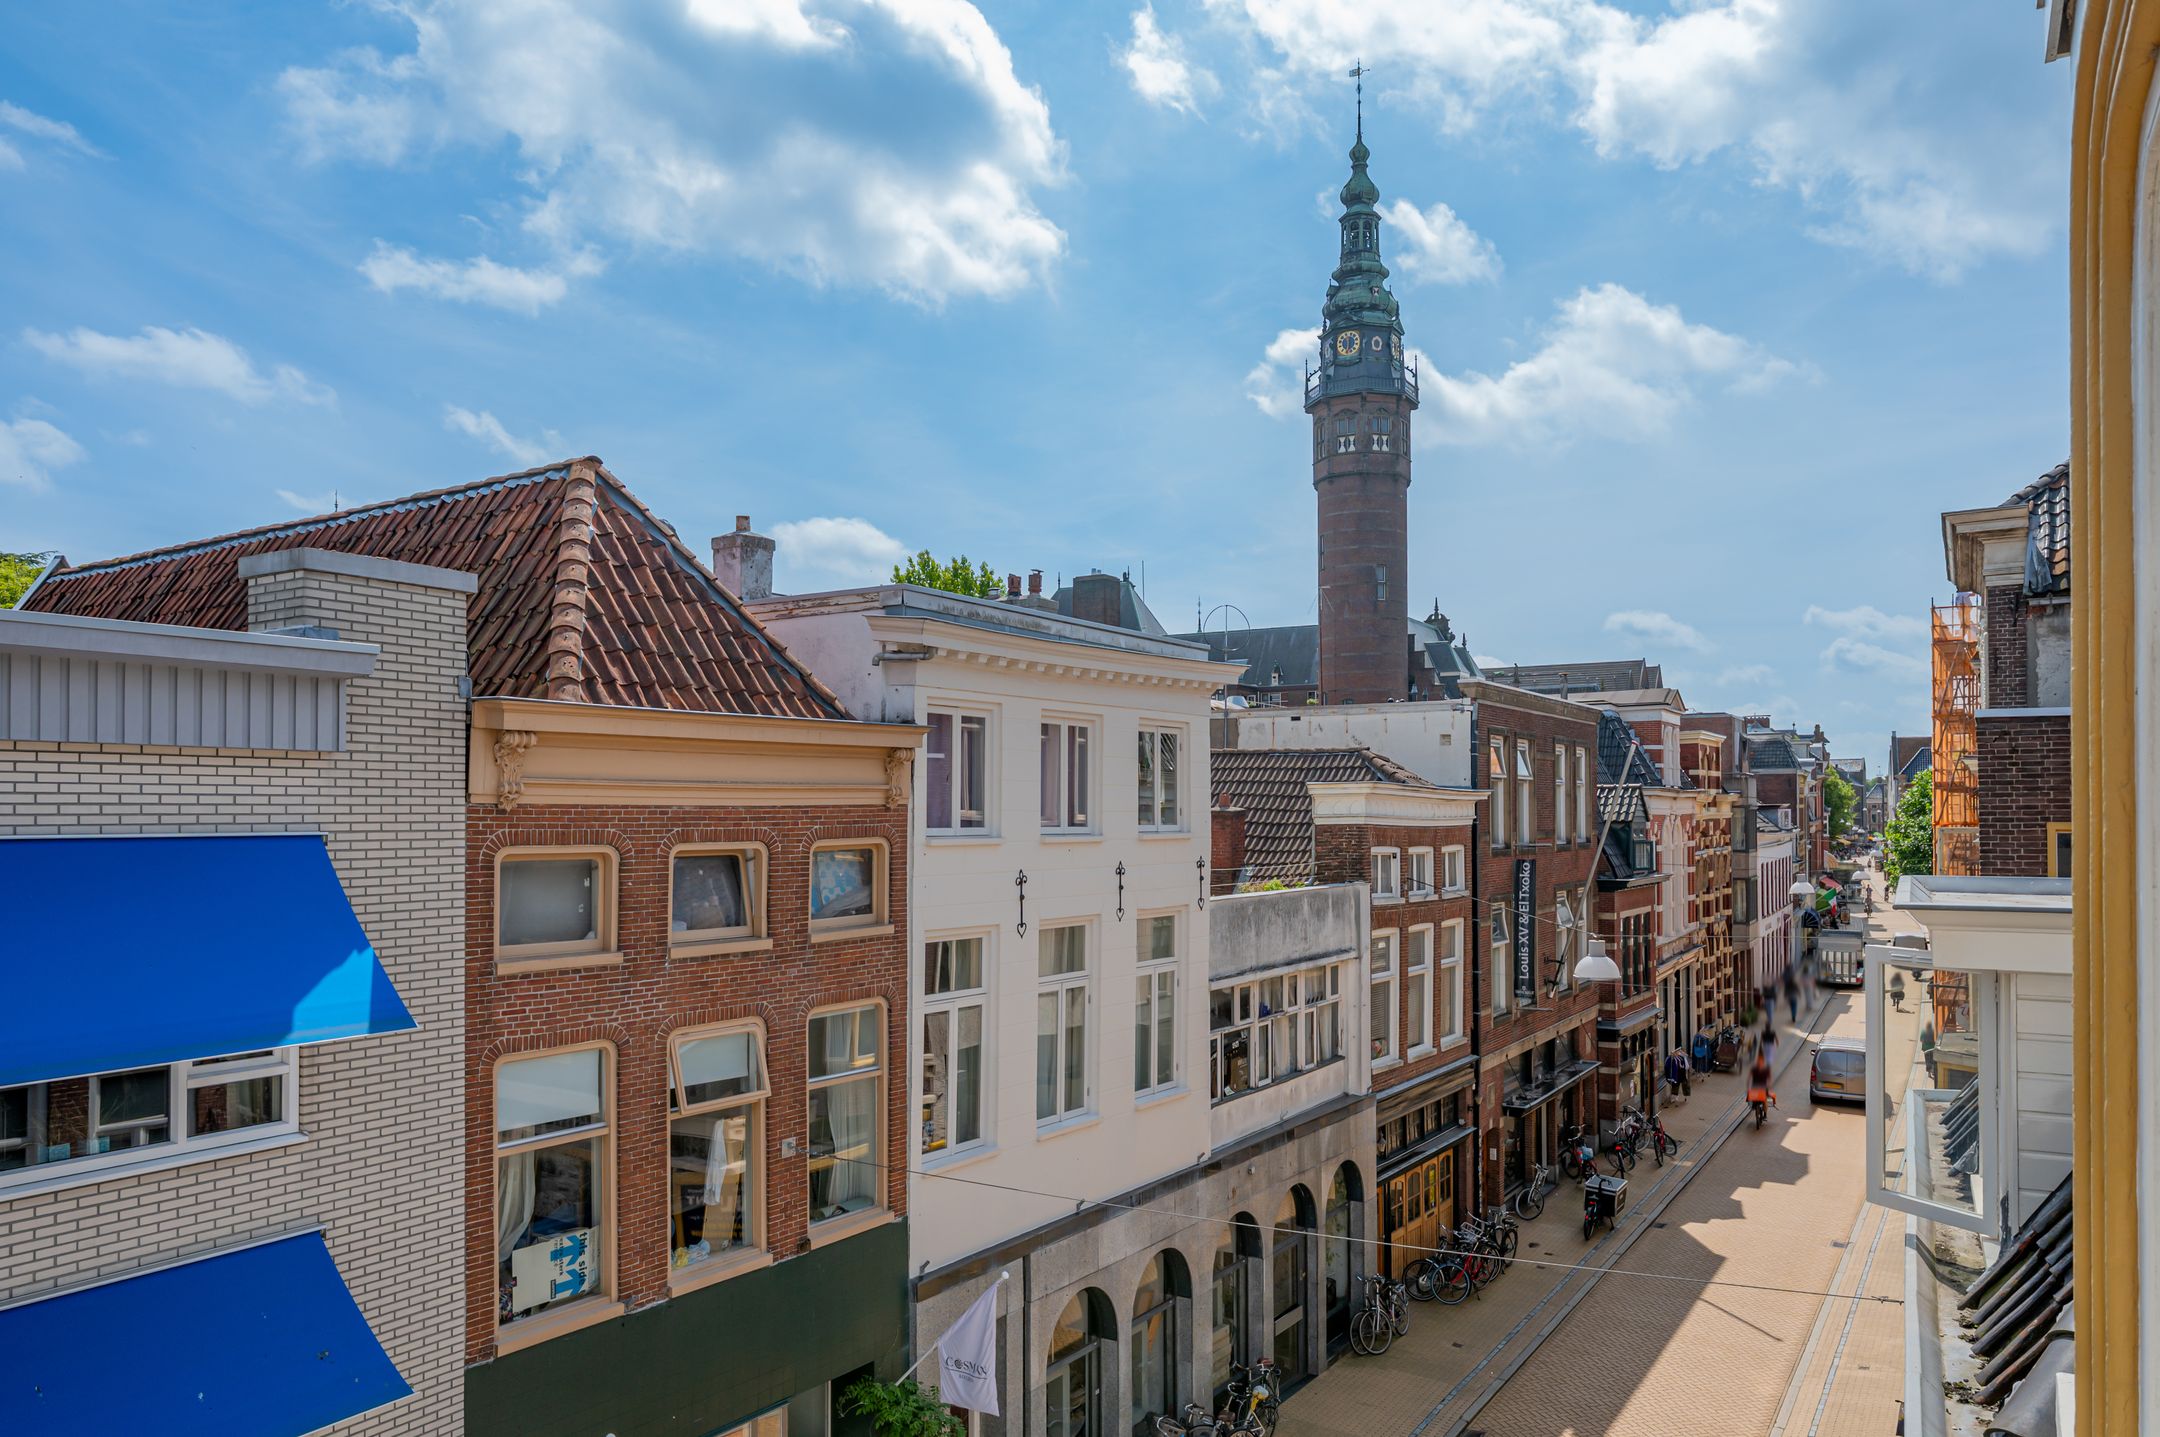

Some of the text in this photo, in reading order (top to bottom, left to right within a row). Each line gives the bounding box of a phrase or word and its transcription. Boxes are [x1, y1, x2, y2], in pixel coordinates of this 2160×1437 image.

[1519, 862, 1531, 900] Txoko
[1518, 913, 1529, 925] &
[1518, 926, 1529, 944] XV
[1518, 946, 1529, 979] Louis
[579, 1231, 587, 1257] this
